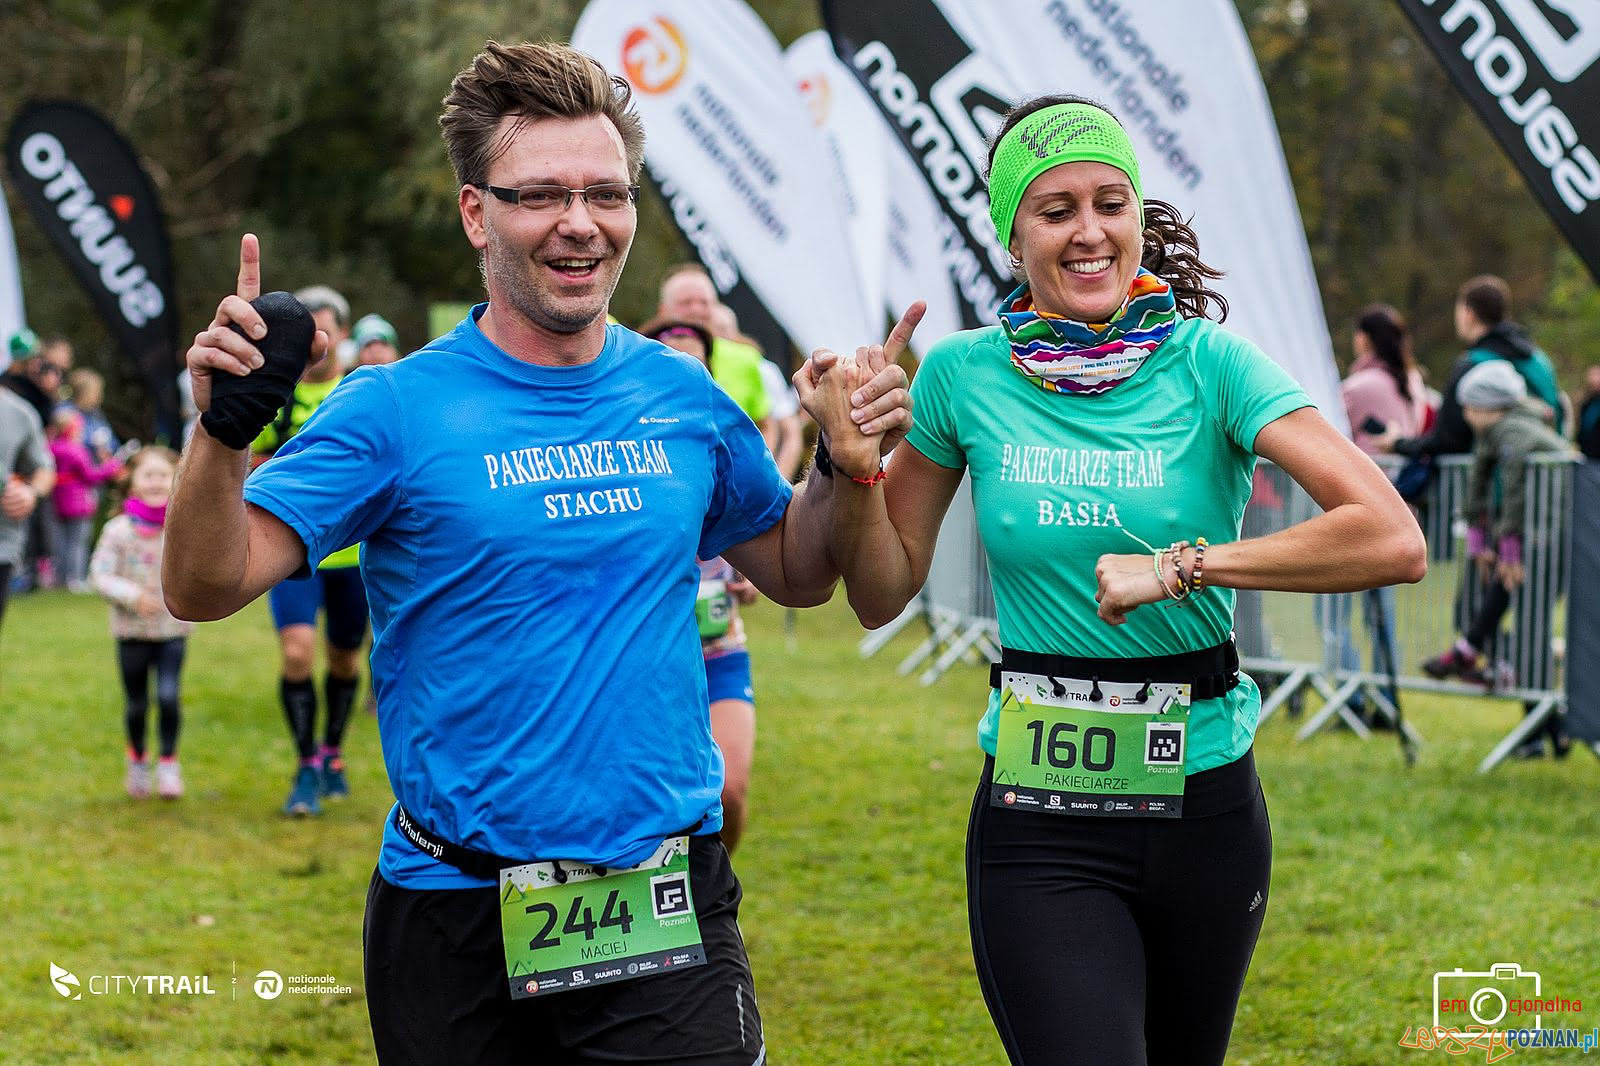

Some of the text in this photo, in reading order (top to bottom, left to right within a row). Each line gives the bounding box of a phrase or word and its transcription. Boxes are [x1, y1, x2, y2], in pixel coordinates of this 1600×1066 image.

[1086, 0, 1190, 114] ationale
[1046, 0, 1202, 192] nederlanden
[484, 440, 672, 489] PAKIECIARZE TEAM
[1000, 443, 1165, 488] PAKIECIARZE TEAM
[544, 487, 643, 519] STACHU
[1037, 500, 1123, 527] BASIA
[1027, 719, 1116, 772] 160
[1044, 772, 1129, 790] PAKIECIARZE
[1071, 802, 1098, 810] SUUNTO
[525, 889, 634, 950] 244
[580, 941, 628, 960] MACIEJ
[595, 969, 622, 980] SUUNTO
